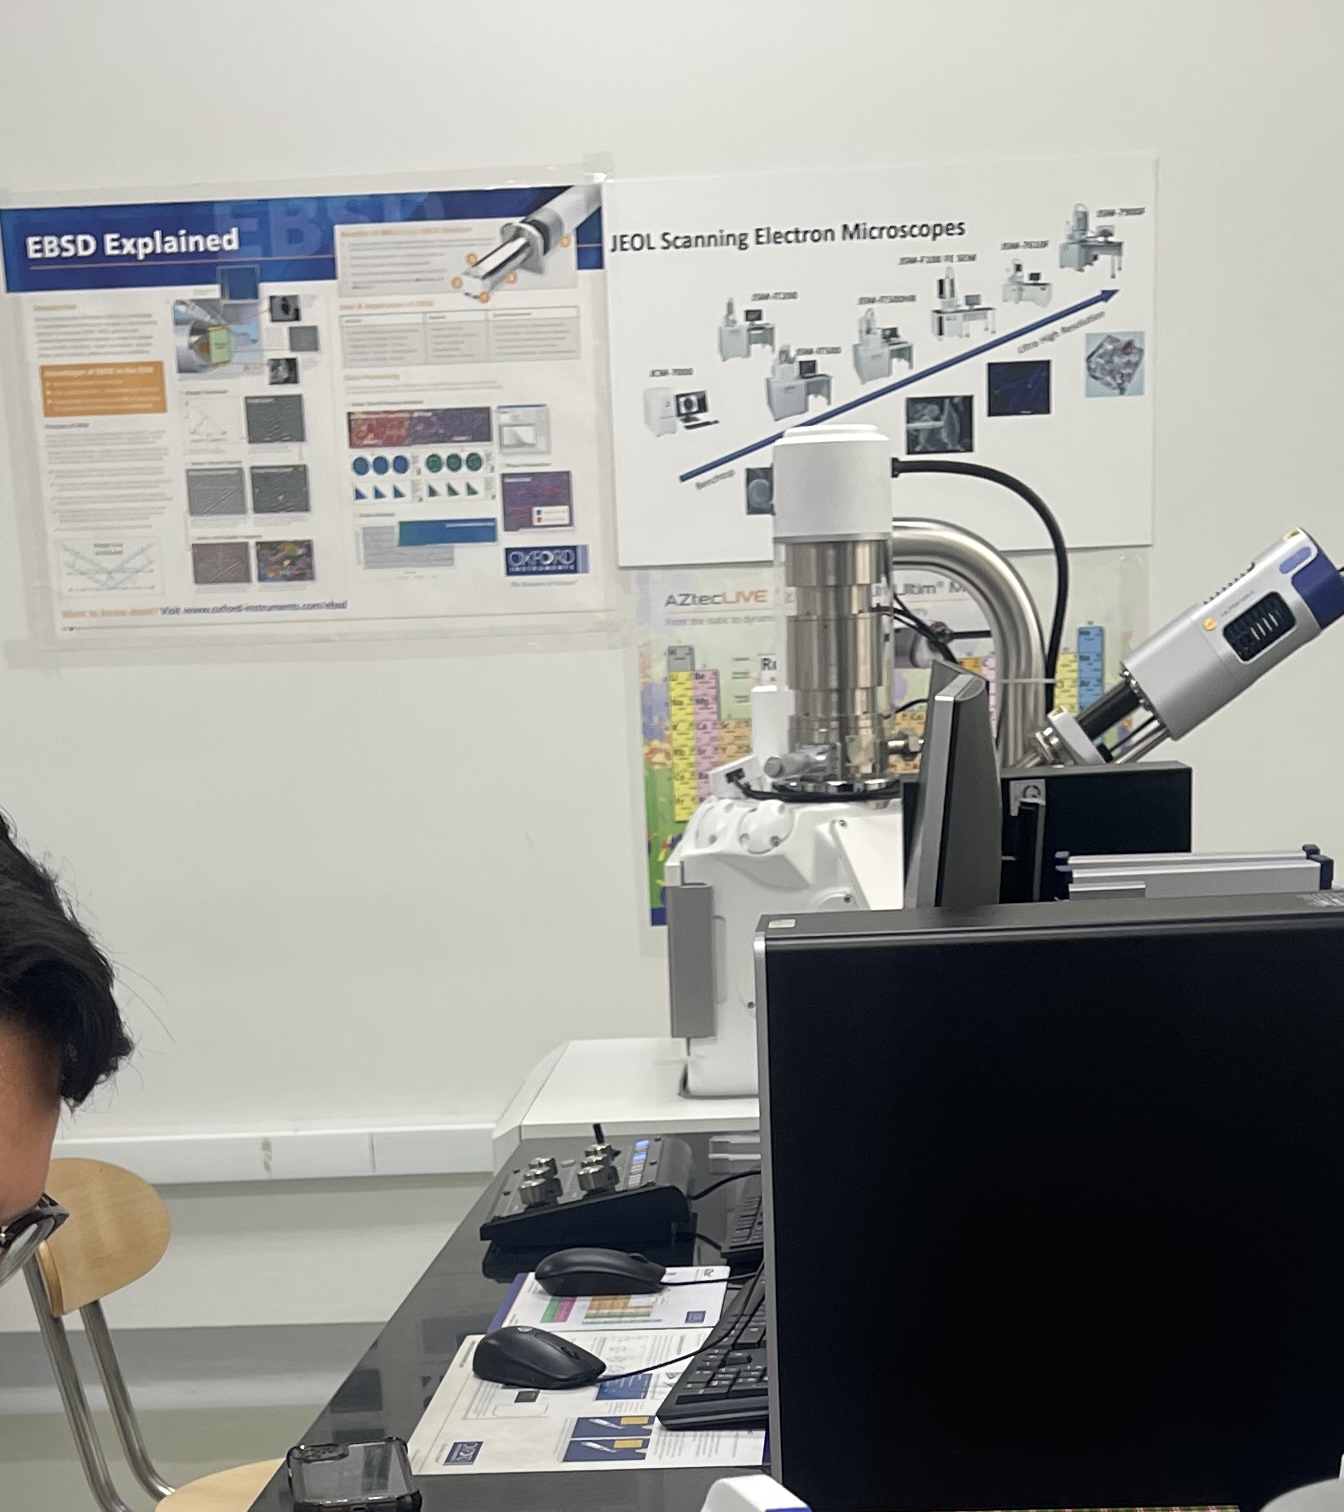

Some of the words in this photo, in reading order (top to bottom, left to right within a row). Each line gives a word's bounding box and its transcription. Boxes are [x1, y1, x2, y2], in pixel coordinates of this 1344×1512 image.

[25, 234, 97, 259] EBSD
[103, 227, 240, 260] Explained
[611, 232, 656, 252] JEOL
[660, 229, 749, 250] Scanning
[755, 227, 836, 246] Electron
[842, 220, 966, 242] Microscopes
[665, 589, 768, 607] AZtecLIVE
